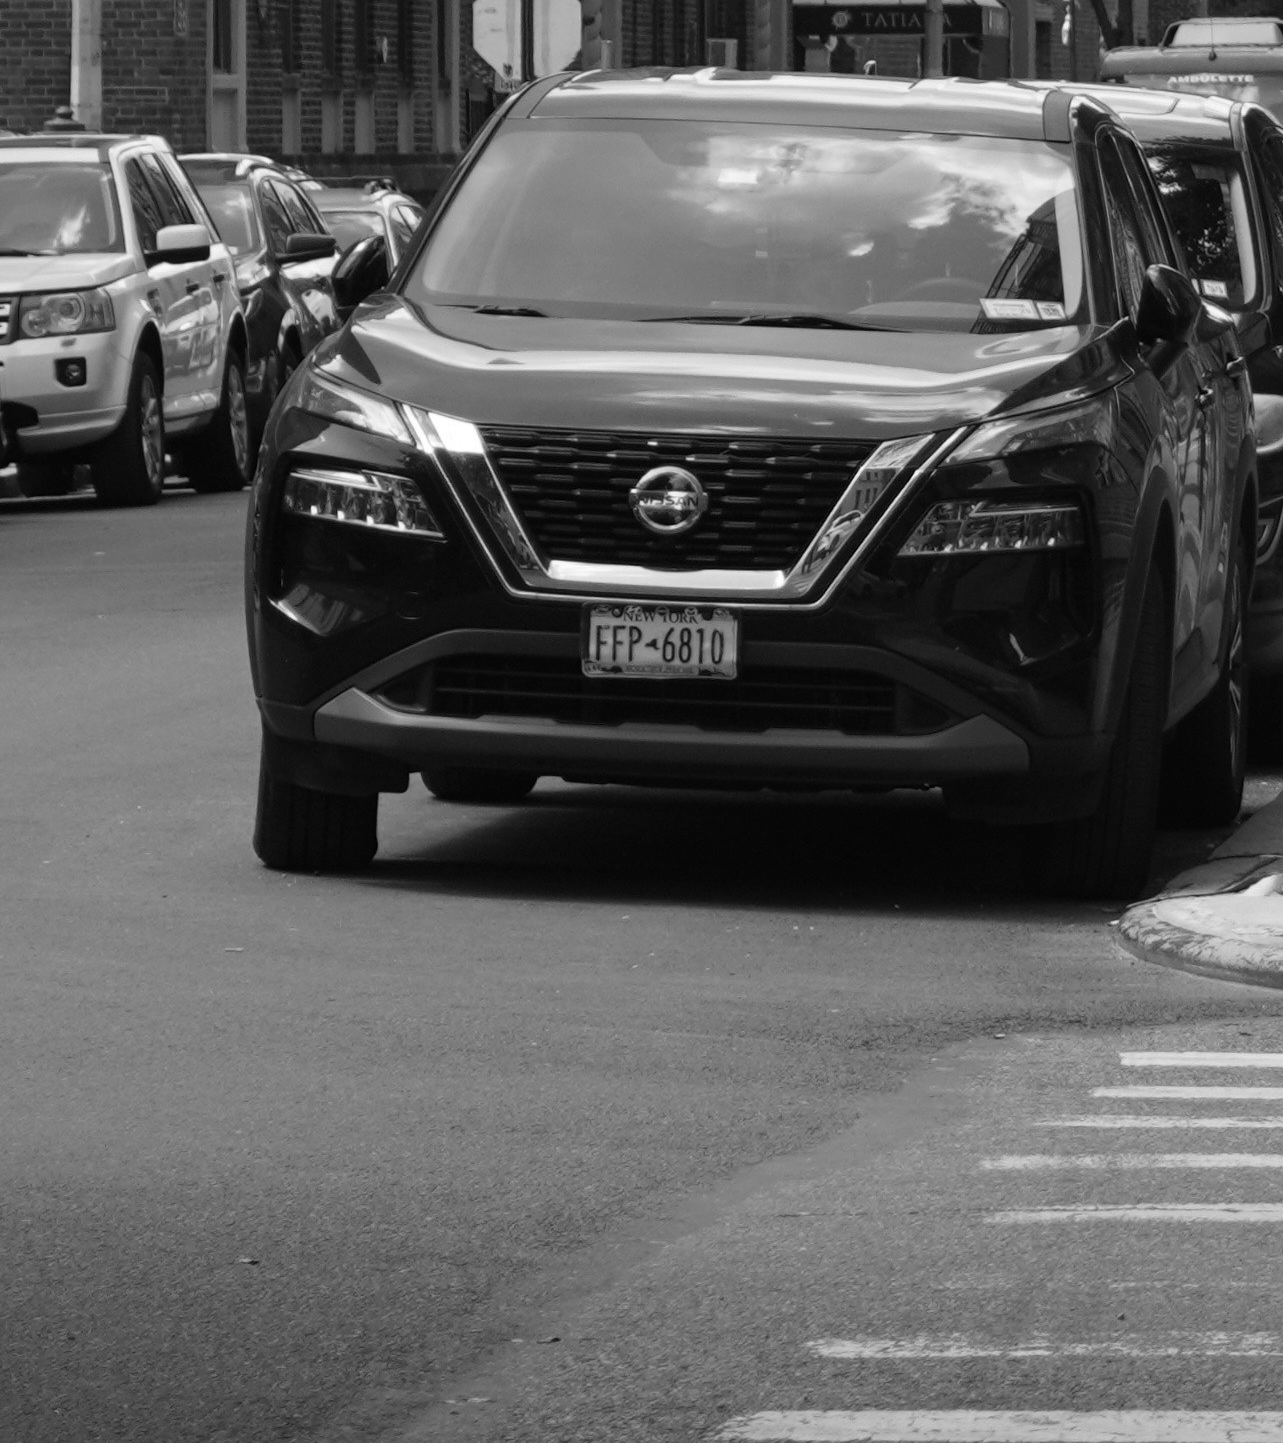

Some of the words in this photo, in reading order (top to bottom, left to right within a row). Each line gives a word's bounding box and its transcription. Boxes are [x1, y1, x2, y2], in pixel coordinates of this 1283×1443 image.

[861, 12, 952, 27] TATIAA
[1167, 73, 1254, 83] AMBULETTE
[638, 497, 699, 506] NISSAN
[623, 610, 657, 623] NEW
[595, 625, 643, 662] FFP
[662, 627, 725, 665] 6810
